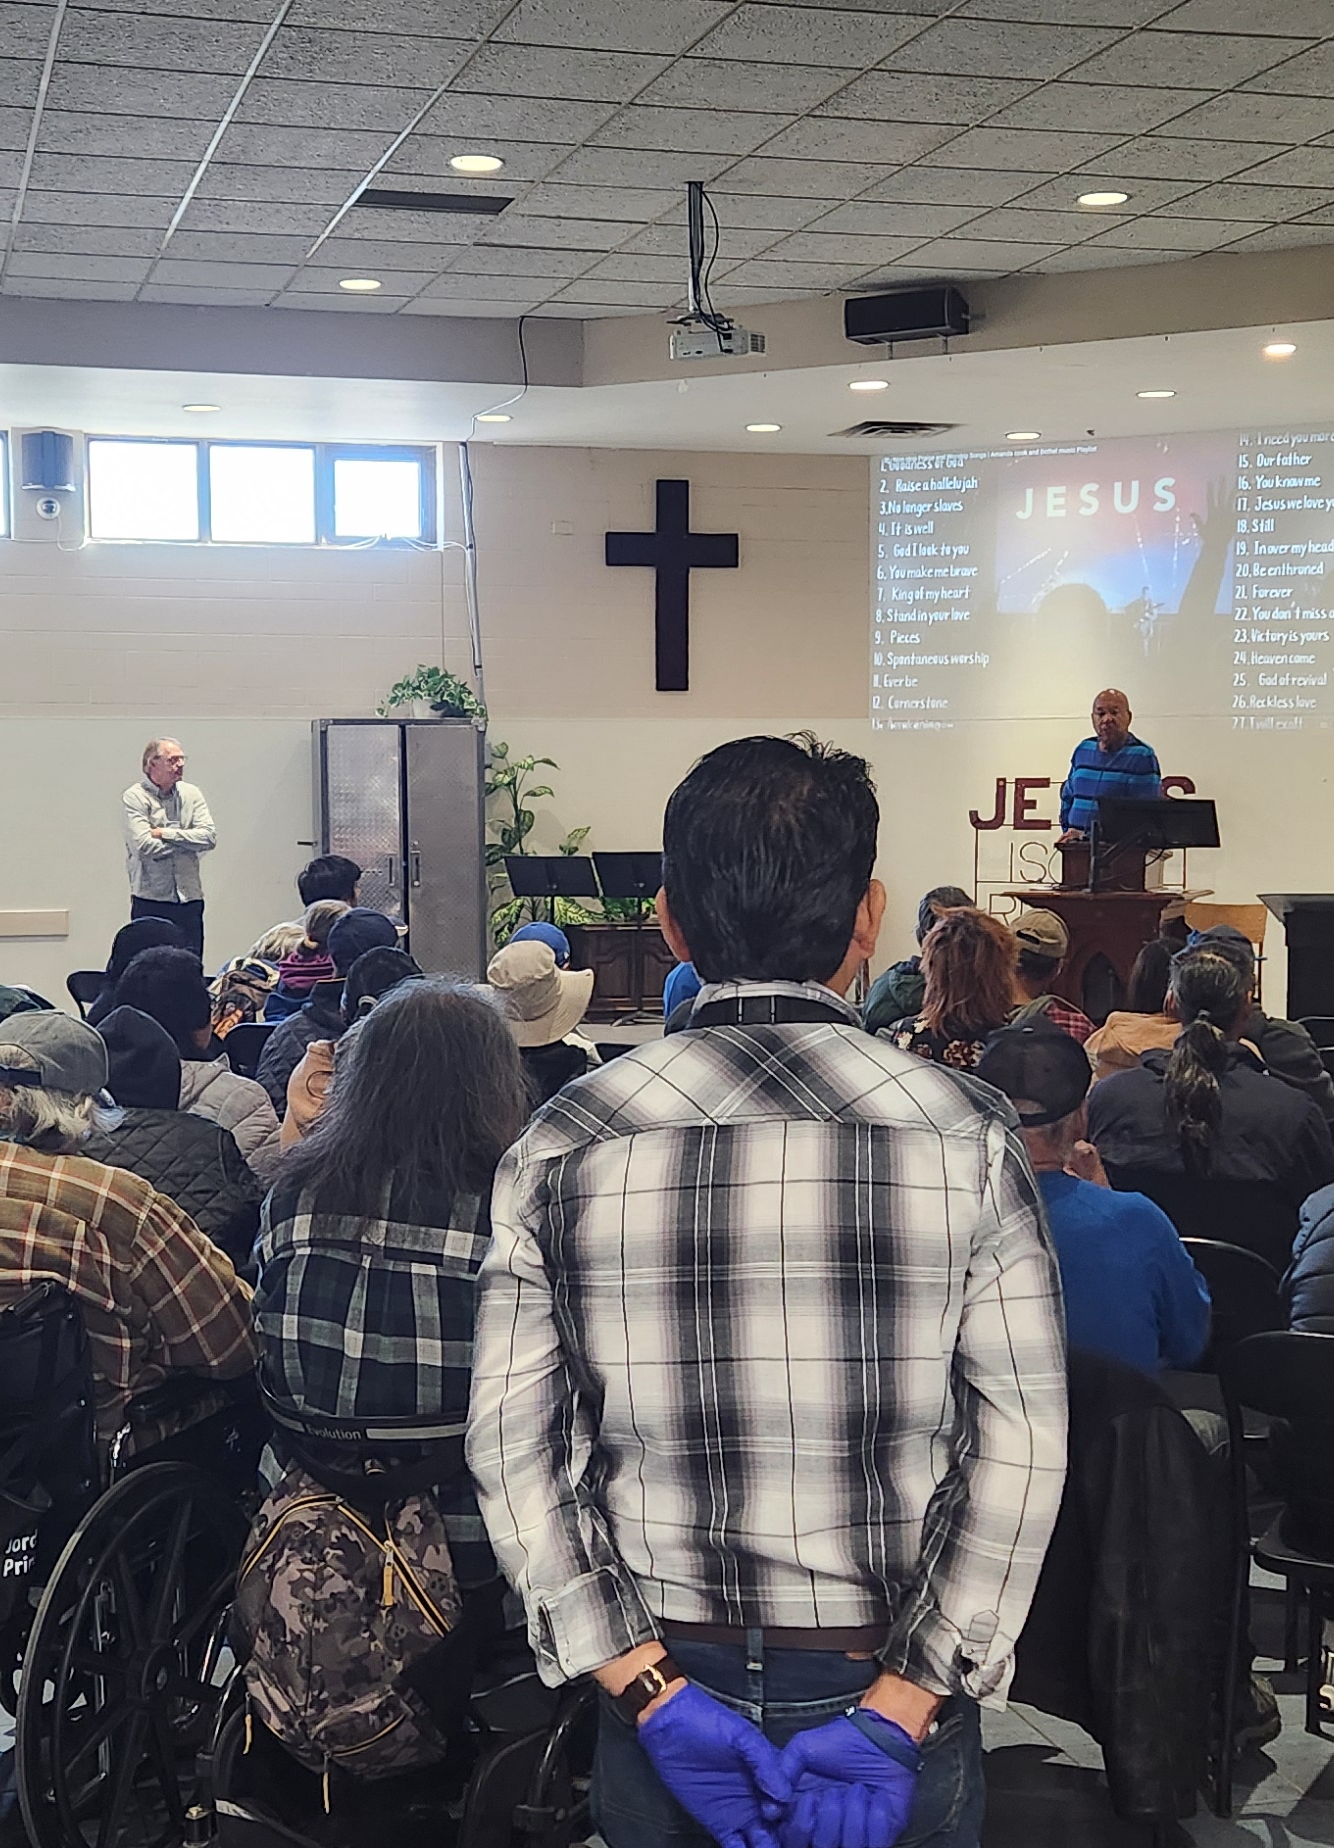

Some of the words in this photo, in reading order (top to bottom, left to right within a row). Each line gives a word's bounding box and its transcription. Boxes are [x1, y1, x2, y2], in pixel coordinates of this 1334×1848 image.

[1257, 433, 1262, 445] I
[1264, 431, 1289, 445] need
[1292, 433, 1308, 448] you
[1239, 454, 1252, 468] 15.
[1256, 454, 1275, 467] Our
[1276, 452, 1312, 466] father
[880, 480, 889, 493] 2.
[896, 479, 921, 492] Raise
[930, 476, 978, 493] hallelujah
[1238, 476, 1251, 490] 16.
[1256, 475, 1274, 489] You
[1275, 475, 1304, 488] know
[1305, 477, 1321, 486] me
[1016, 476, 1175, 519] JESUS
[1237, 497, 1250, 512] 17.
[1255, 496, 1286, 511] Jesus
[1287, 499, 1302, 509] we
[1304, 495, 1324, 508] love
[902, 500, 933, 517] longer
[934, 498, 964, 512] slaves
[878, 522, 888, 535] 4.
[891, 522, 902, 534] It
[905, 524, 912, 534] is
[914, 521, 934, 533] well
[1237, 519, 1249, 533] 18.
[1252, 518, 1274, 532] Still
[878, 544, 888, 558] 5.
[894, 542, 910, 557] God
[912, 543, 917, 556] I
[919, 543, 938, 556] look
[940, 542, 950, 555] to
[952, 544, 970, 559] you
[1237, 542, 1249, 556] 19.
[1254, 541, 1266, 555] In
[1268, 545, 1290, 554] over
[1291, 544, 1307, 558] my
[1308, 539, 1334, 552] head
[877, 566, 887, 580] 6.
[889, 565, 906, 579] You
[907, 565, 933, 578] make
[934, 569, 949, 577] me
[950, 564, 979, 576] brave
[1236, 564, 1251, 578] 20.
[1253, 563, 1266, 576] Be
[1268, 562, 1324, 576] enthroned
[878, 587, 885, 601] 7.
[892, 586, 914, 604] King
[915, 586, 924, 599] of
[926, 590, 940, 604] my
[941, 585, 970, 598] heart
[1235, 586, 1247, 599] 21.
[1252, 584, 1293, 598] Forever
[876, 609, 884, 622] 8.
[887, 608, 916, 622] Stand
[918, 610, 927, 620] in
[928, 611, 950, 625] your
[951, 607, 970, 620] love
[1235, 608, 1251, 621] 22.
[1252, 607, 1270, 620] You
[1302, 608, 1327, 619] miss
[875, 630, 885, 645] 9.
[891, 630, 920, 643] Pieces
[1251, 628, 1287, 646] Victory
[1289, 630, 1298, 641] is
[1300, 631, 1329, 645] yours
[874, 652, 886, 666] 10.
[887, 652, 949, 670] Spontaneous
[951, 651, 989, 668] worship
[1251, 651, 1287, 664] Heaven
[1289, 655, 1316, 663] come
[884, 674, 904, 687] Ever
[905, 675, 918, 687] be
[1259, 673, 1277, 685] God
[1279, 673, 1290, 685] of
[1291, 673, 1327, 686] revival
[888, 695, 948, 709] Cornerstone
[1250, 695, 1294, 708] Reckless
[1296, 695, 1316, 708] love
[306, 1424, 361, 1440] Evolution
